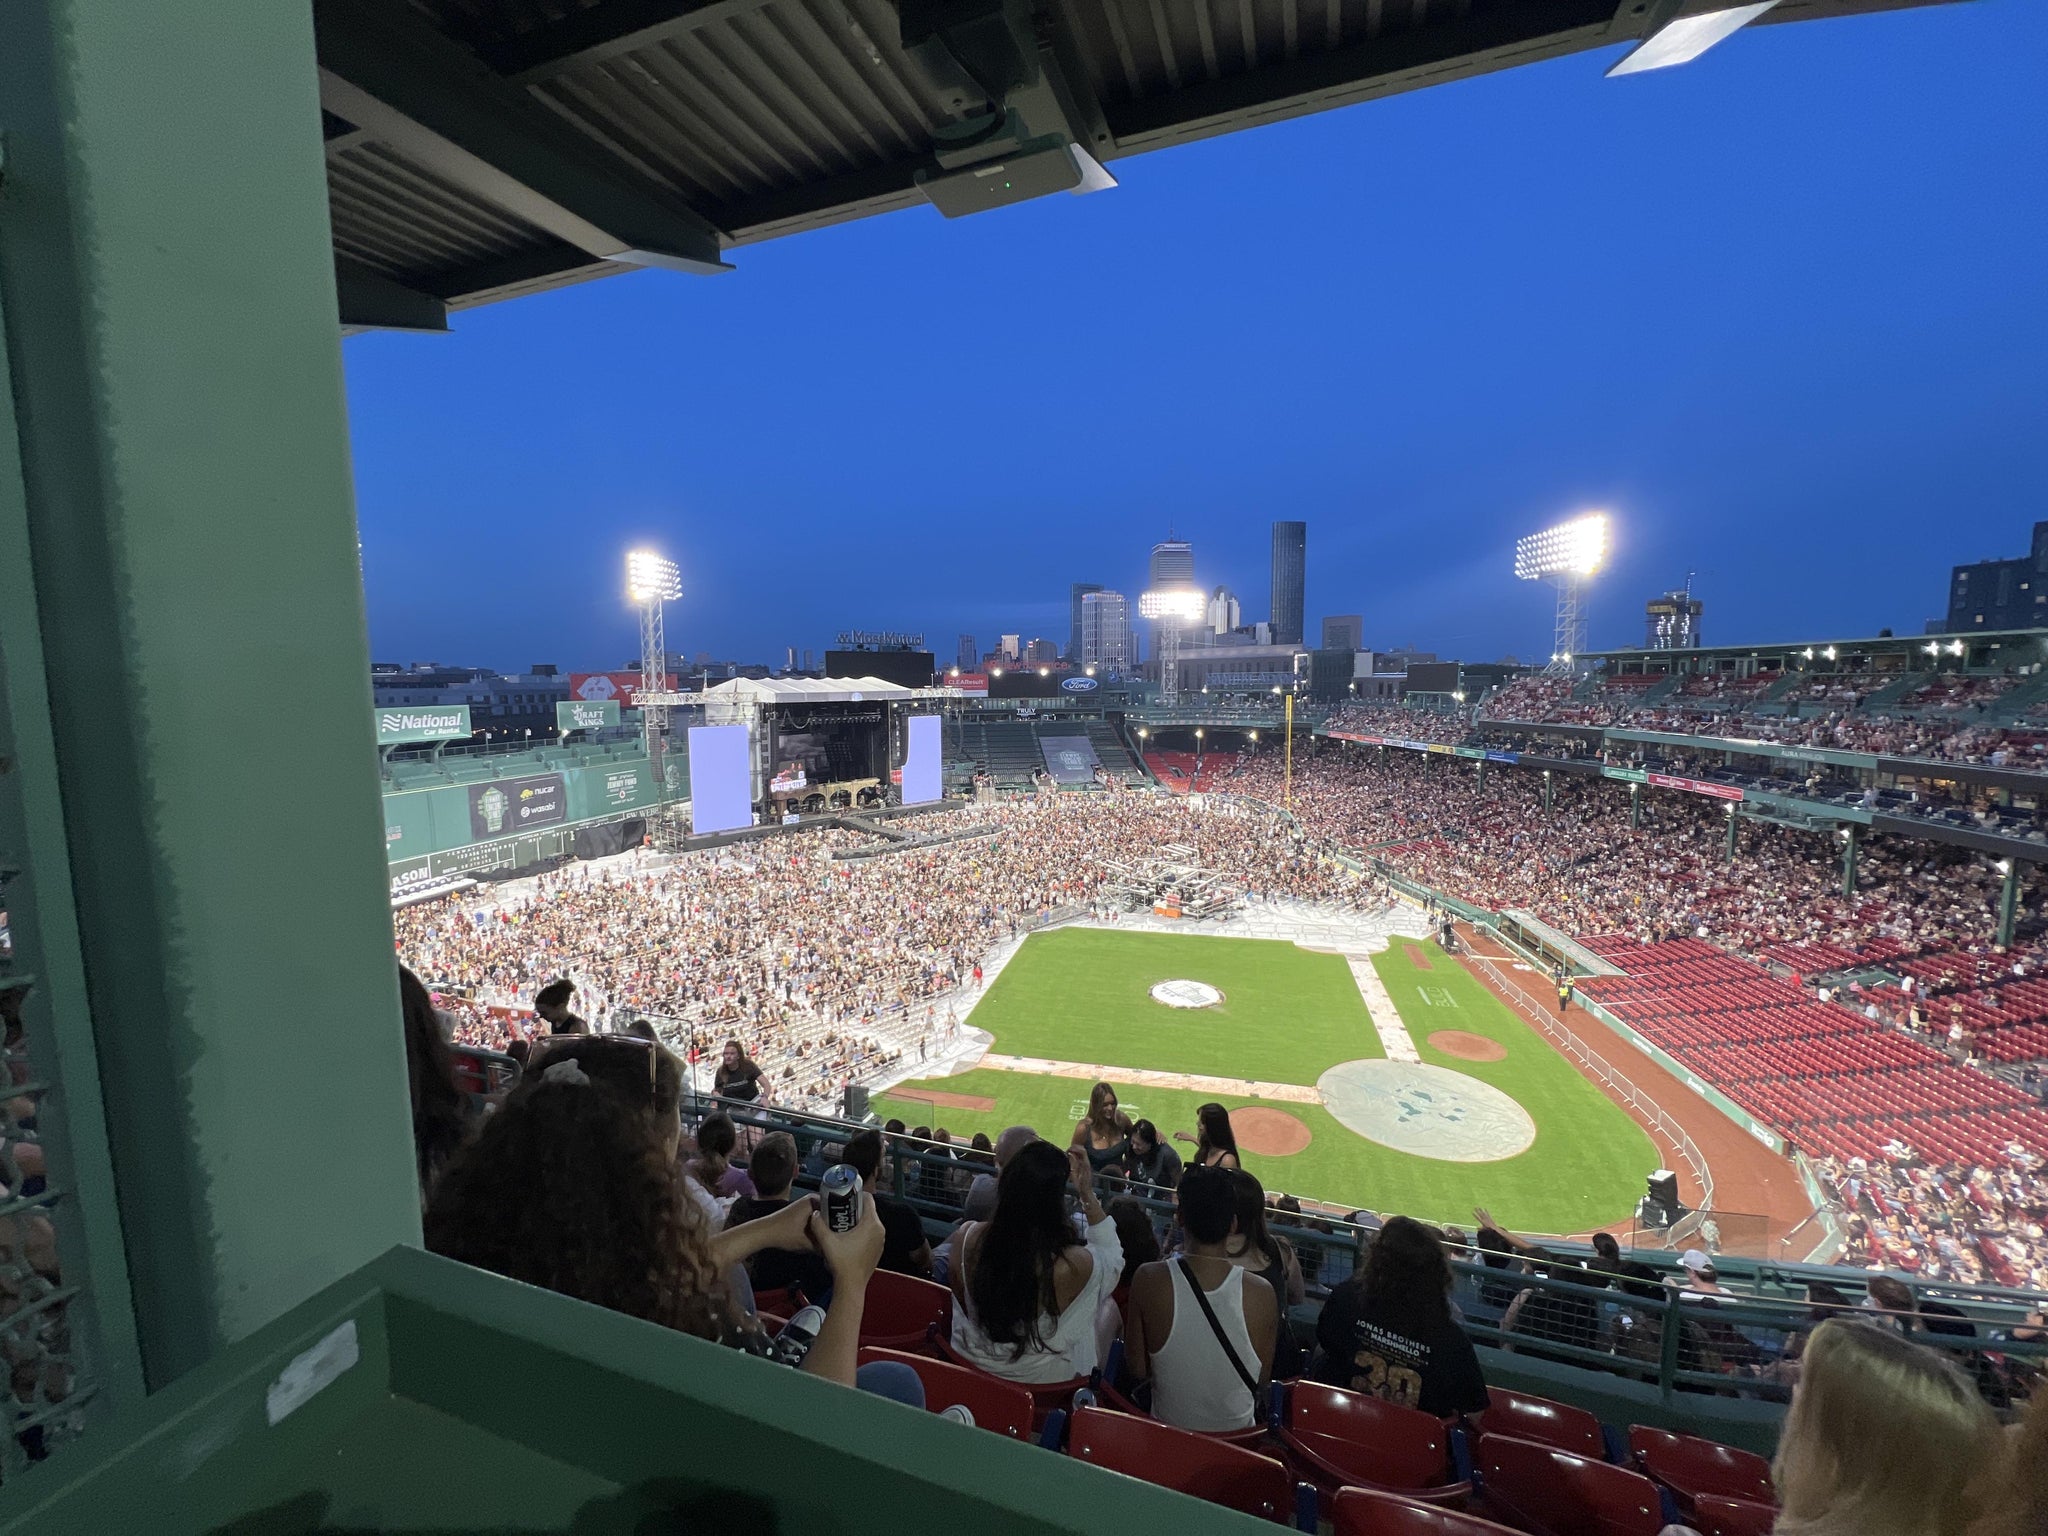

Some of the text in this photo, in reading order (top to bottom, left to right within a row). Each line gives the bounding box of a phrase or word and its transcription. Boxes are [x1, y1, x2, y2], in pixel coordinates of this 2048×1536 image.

[851, 629, 924, 646] MassMutual
[1068, 680, 1091, 689] Ford
[574, 710, 603, 720] DRAFT
[1016, 707, 1036, 715] TRULY
[402, 713, 460, 729] National
[438, 727, 460, 735] Rental
[535, 786, 555, 794] nucar
[531, 802, 555, 813] wasabi
[392, 867, 428, 887] ASON
[1356, 1320, 1384, 1335] JONAS
[1386, 1330, 1431, 1354] BROTHERS
[1370, 1332, 1420, 1357] MARSHMELLO
